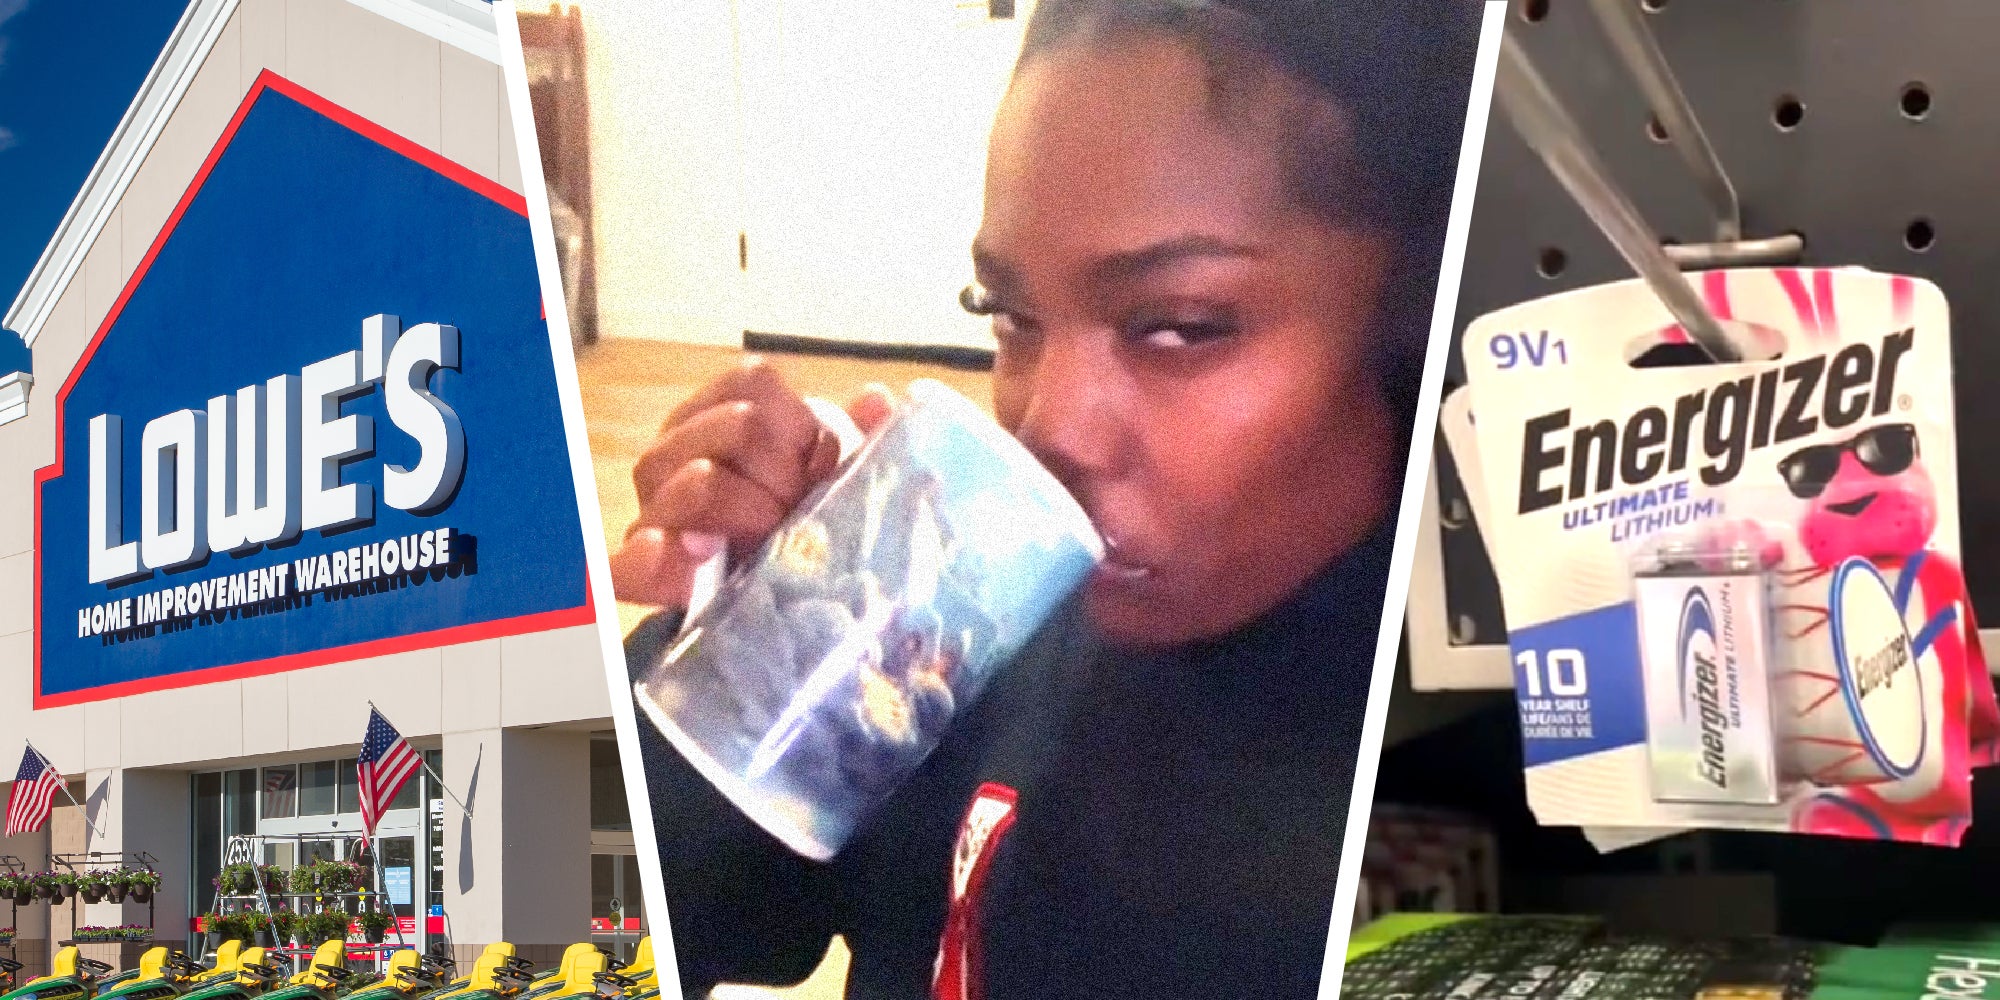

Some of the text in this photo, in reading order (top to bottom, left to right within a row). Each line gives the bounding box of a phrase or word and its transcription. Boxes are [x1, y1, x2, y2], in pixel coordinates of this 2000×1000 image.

[89, 313, 464, 584] LOWE'S
[1517, 327, 1914, 515] Energizer
[1562, 480, 1690, 530] ULTIMATE
[1610, 498, 1715, 543] LITHIUM
[78, 527, 454, 638] HOME IMPROVEMENT WAREHOUSE
[1515, 648, 1587, 696] 10
[1694, 652, 1730, 790] Energizer
